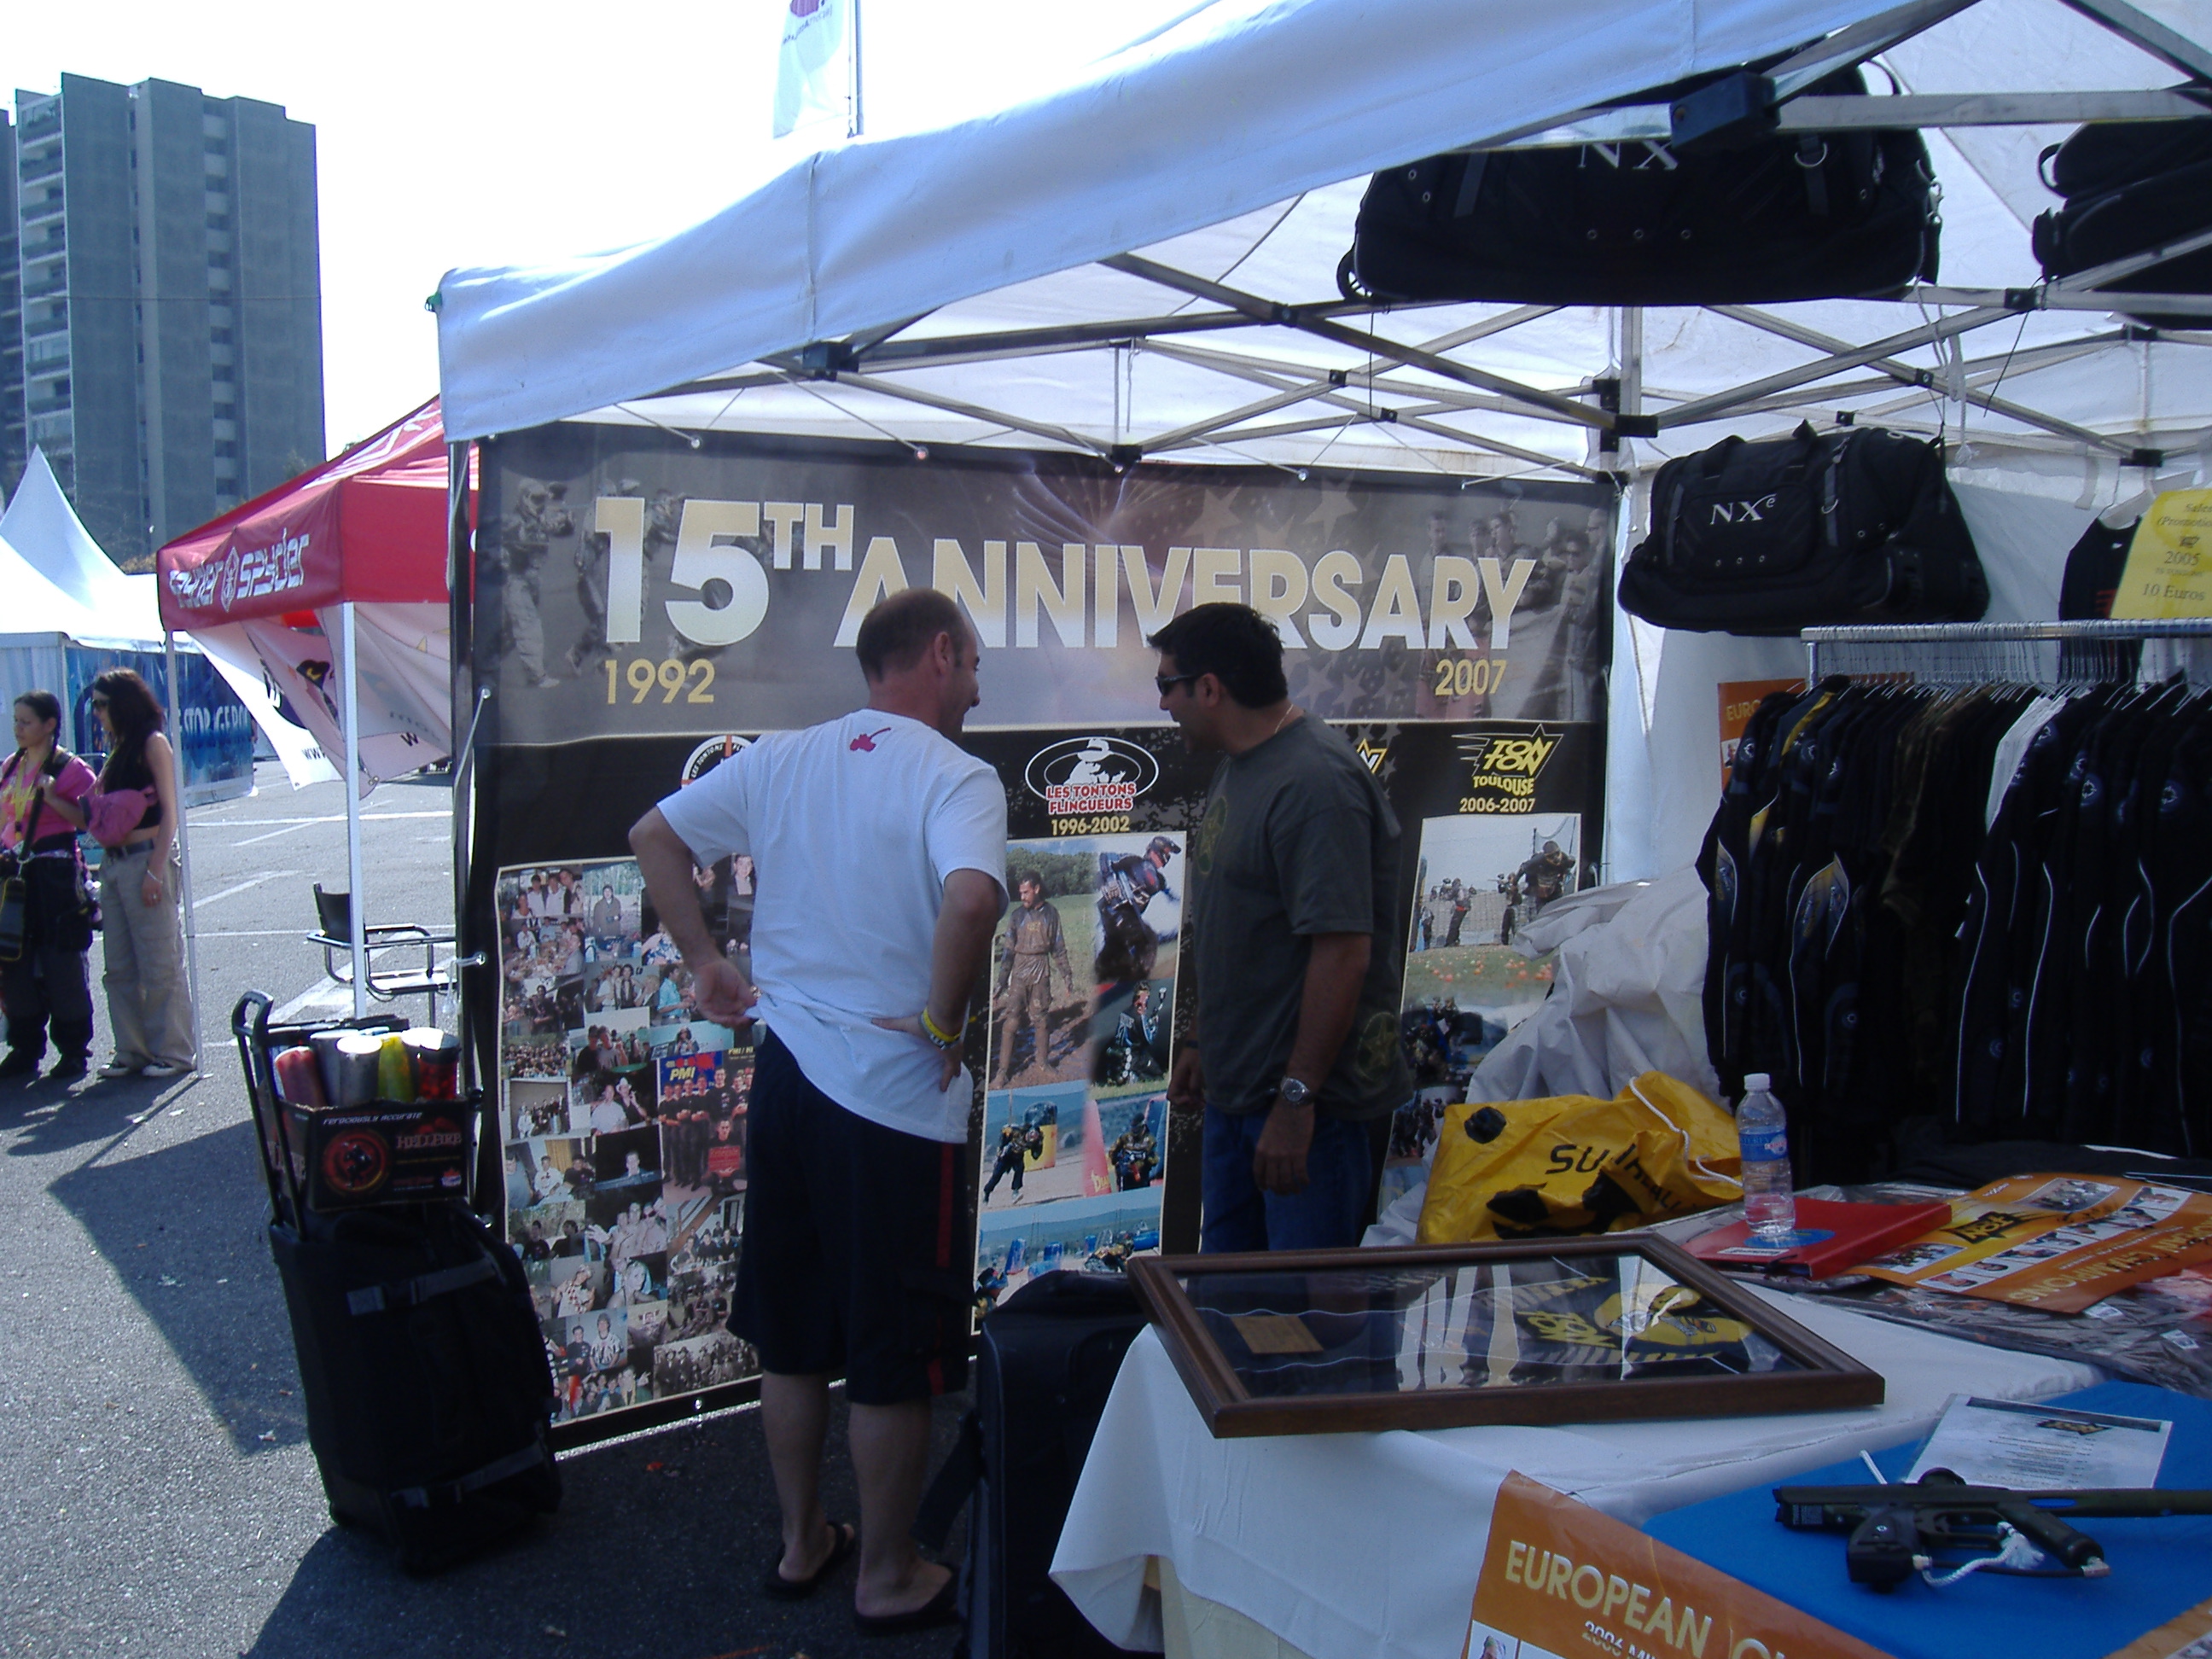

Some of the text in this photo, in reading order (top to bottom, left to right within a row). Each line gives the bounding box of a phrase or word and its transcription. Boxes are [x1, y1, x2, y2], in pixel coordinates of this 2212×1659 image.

[595, 497, 854, 646] 15TH
[833, 537, 1537, 651] ANNIVERSARY
[2142, 583, 2205, 601] 10 Euros
[604, 658, 715, 705] 1992
[1435, 658, 1508, 697] 2007
[1726, 700, 1761, 721] EURO
[1046, 782, 1137, 800] LES TONTONS
[1473, 775, 1534, 796] TOULOUSE
[1049, 797, 1133, 815] FLINGUEURS
[1459, 797, 1536, 812] 2006-2007
[1051, 815, 1130, 835] 1996-2002
[1505, 1540, 1713, 1659] EUROPEAN
